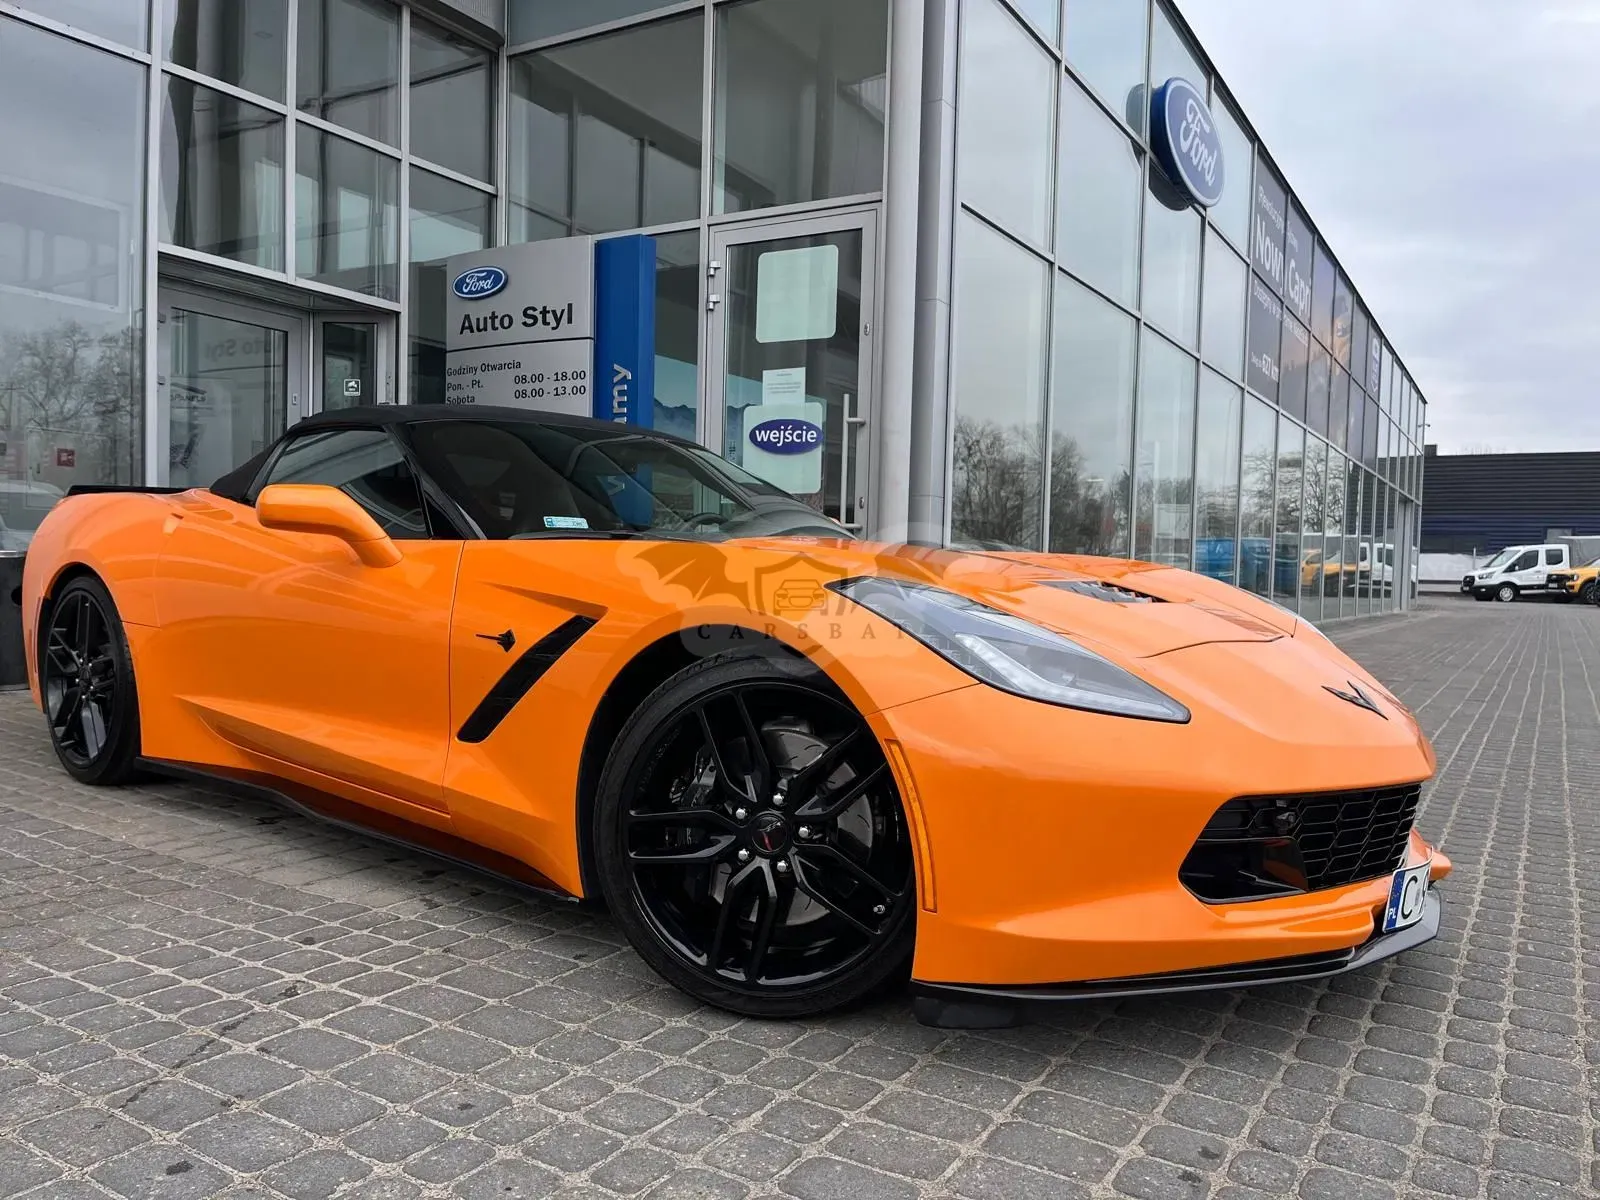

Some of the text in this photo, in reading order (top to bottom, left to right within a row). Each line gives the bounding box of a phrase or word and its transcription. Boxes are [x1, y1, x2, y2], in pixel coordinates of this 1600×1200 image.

[1180, 98, 1217, 186] Ford
[462, 271, 495, 293] Ford
[460, 303, 573, 335] Auto Styl
[446, 360, 522, 377] Godziny Otwarcia
[514, 373, 545, 385] 08.00
[553, 370, 587, 382] 18.00
[447, 382, 464, 393] Pon.
[471, 379, 484, 389] Pt.
[514, 387, 545, 400] 08.00
[553, 384, 587, 397] 13.00
[446, 394, 476, 406] Sobota
[755, 425, 817, 447] wejście
[1387, 907, 1397, 920] PL
